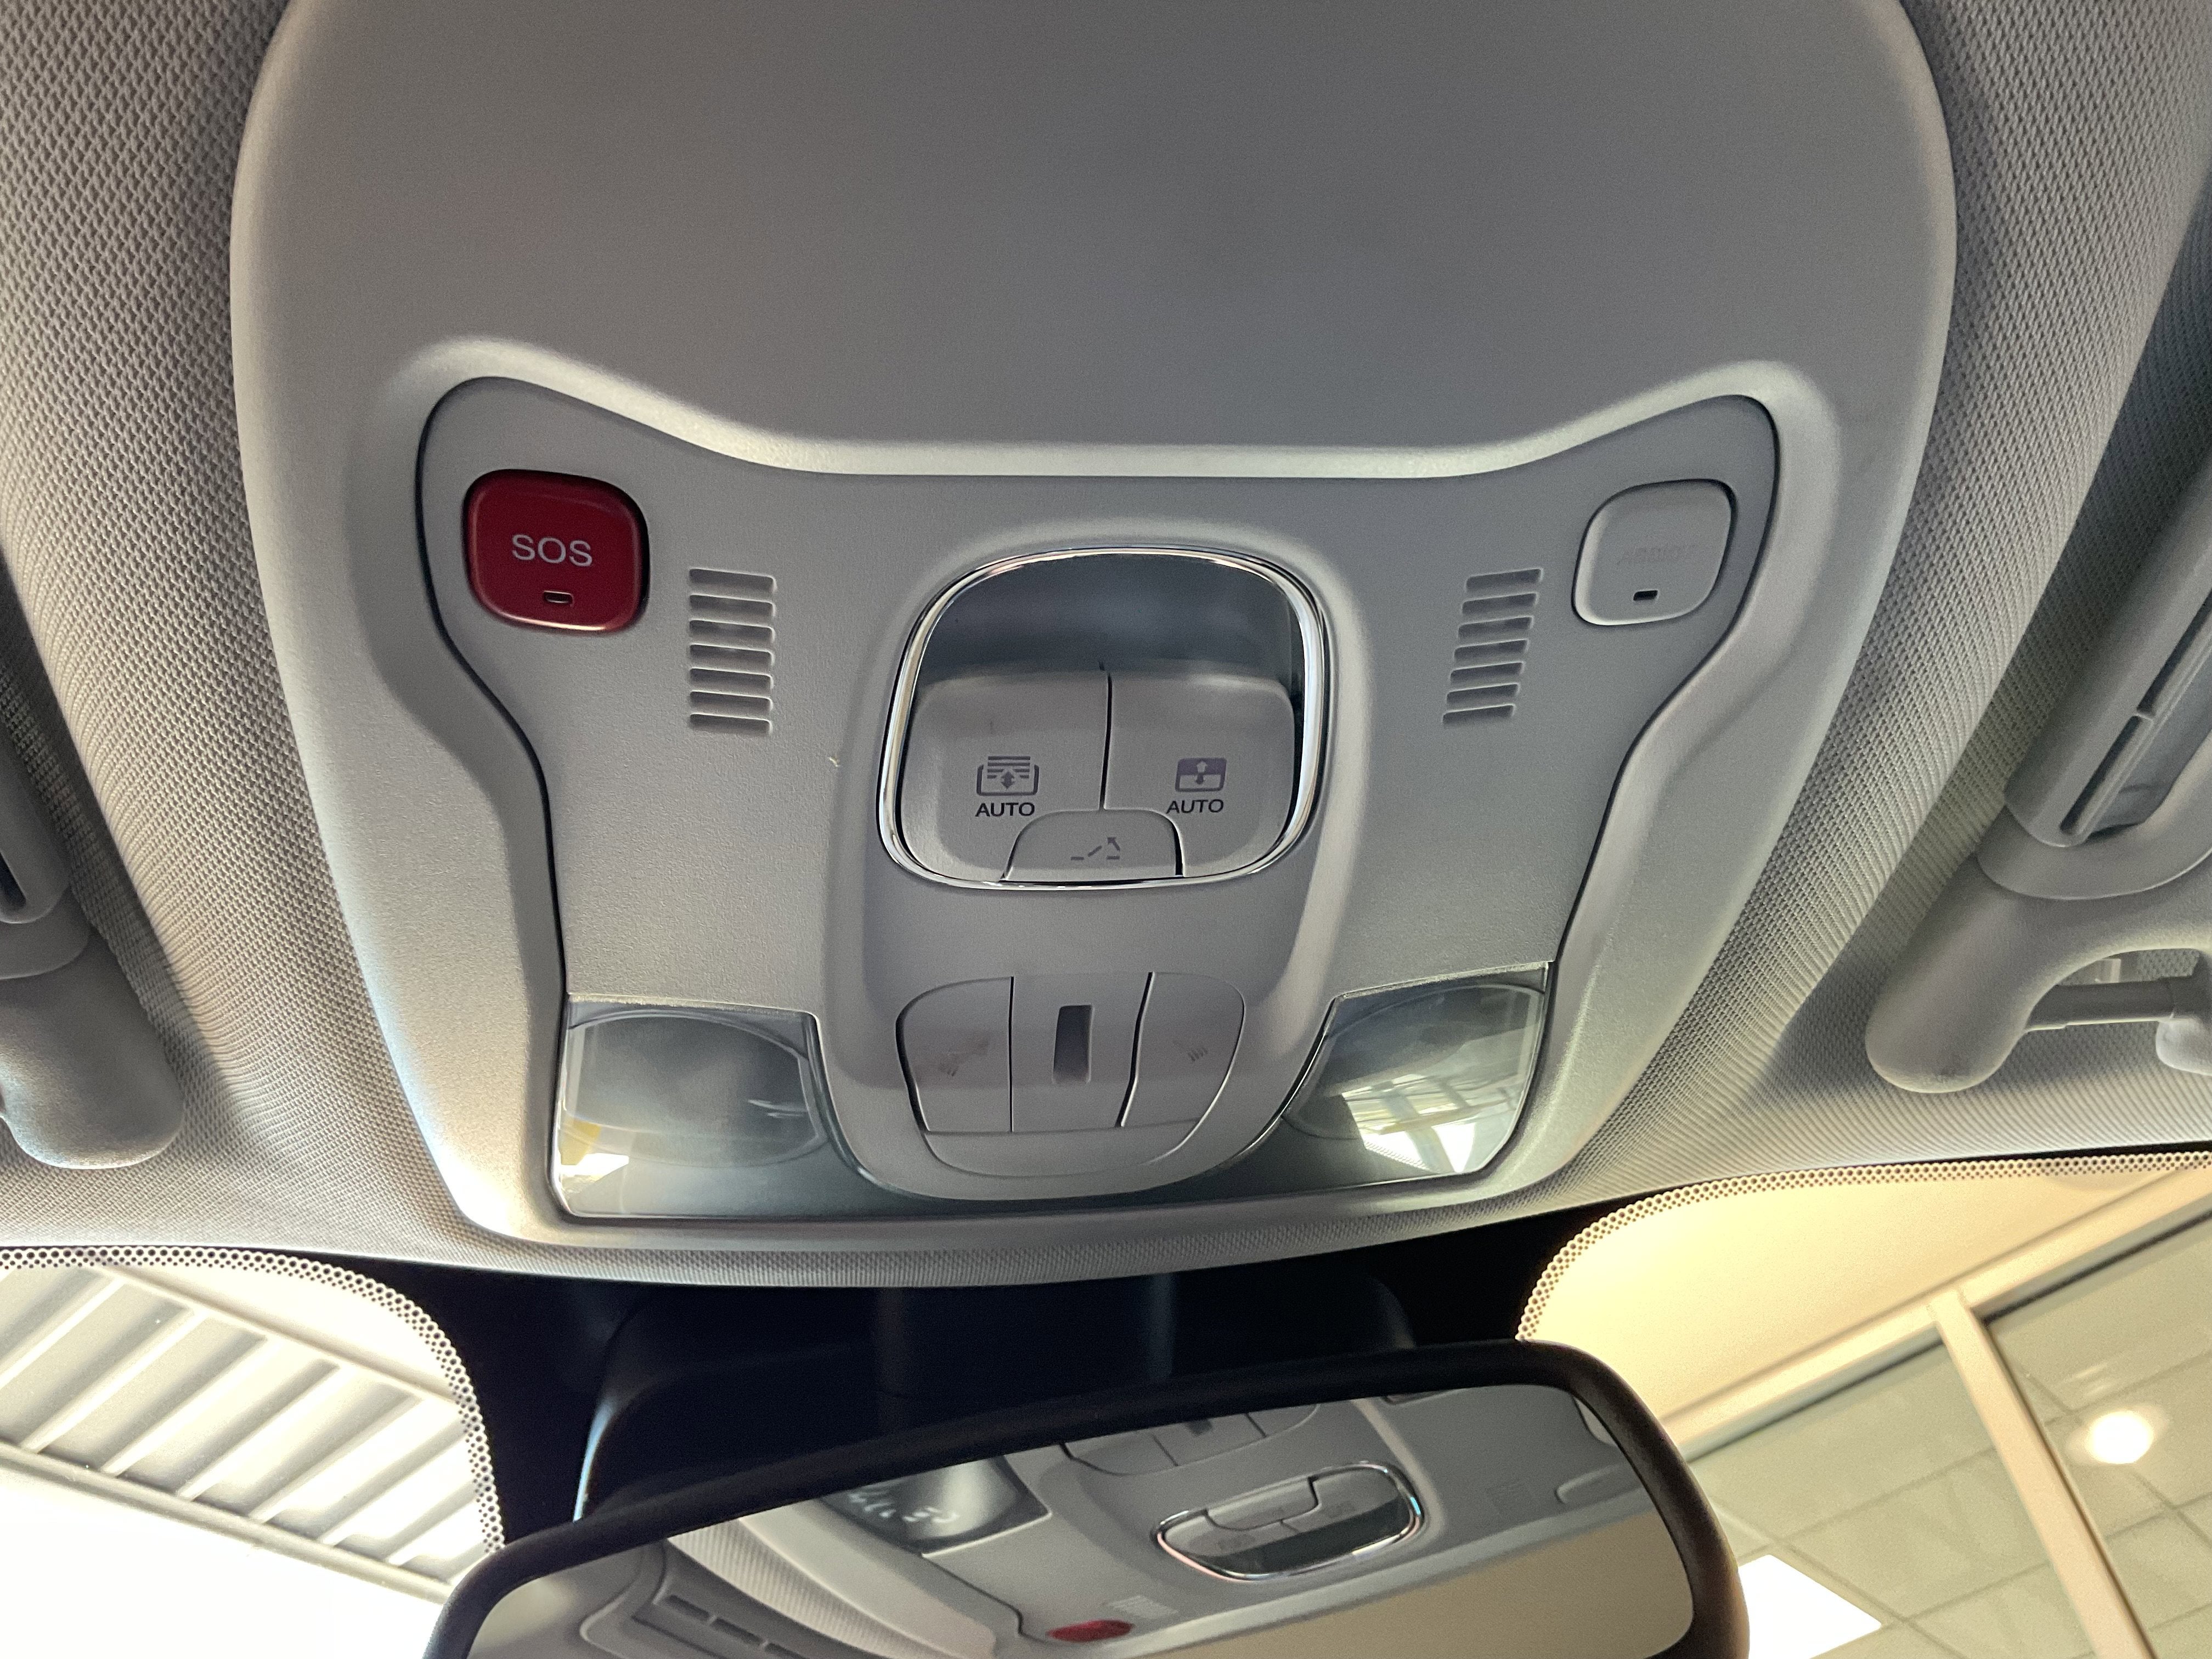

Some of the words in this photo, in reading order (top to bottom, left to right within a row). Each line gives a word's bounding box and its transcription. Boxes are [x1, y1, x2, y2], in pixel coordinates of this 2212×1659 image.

[512, 534, 593, 566] SOS
[975, 802, 1036, 817] AUTO
[1166, 798, 1224, 814] AUTO
